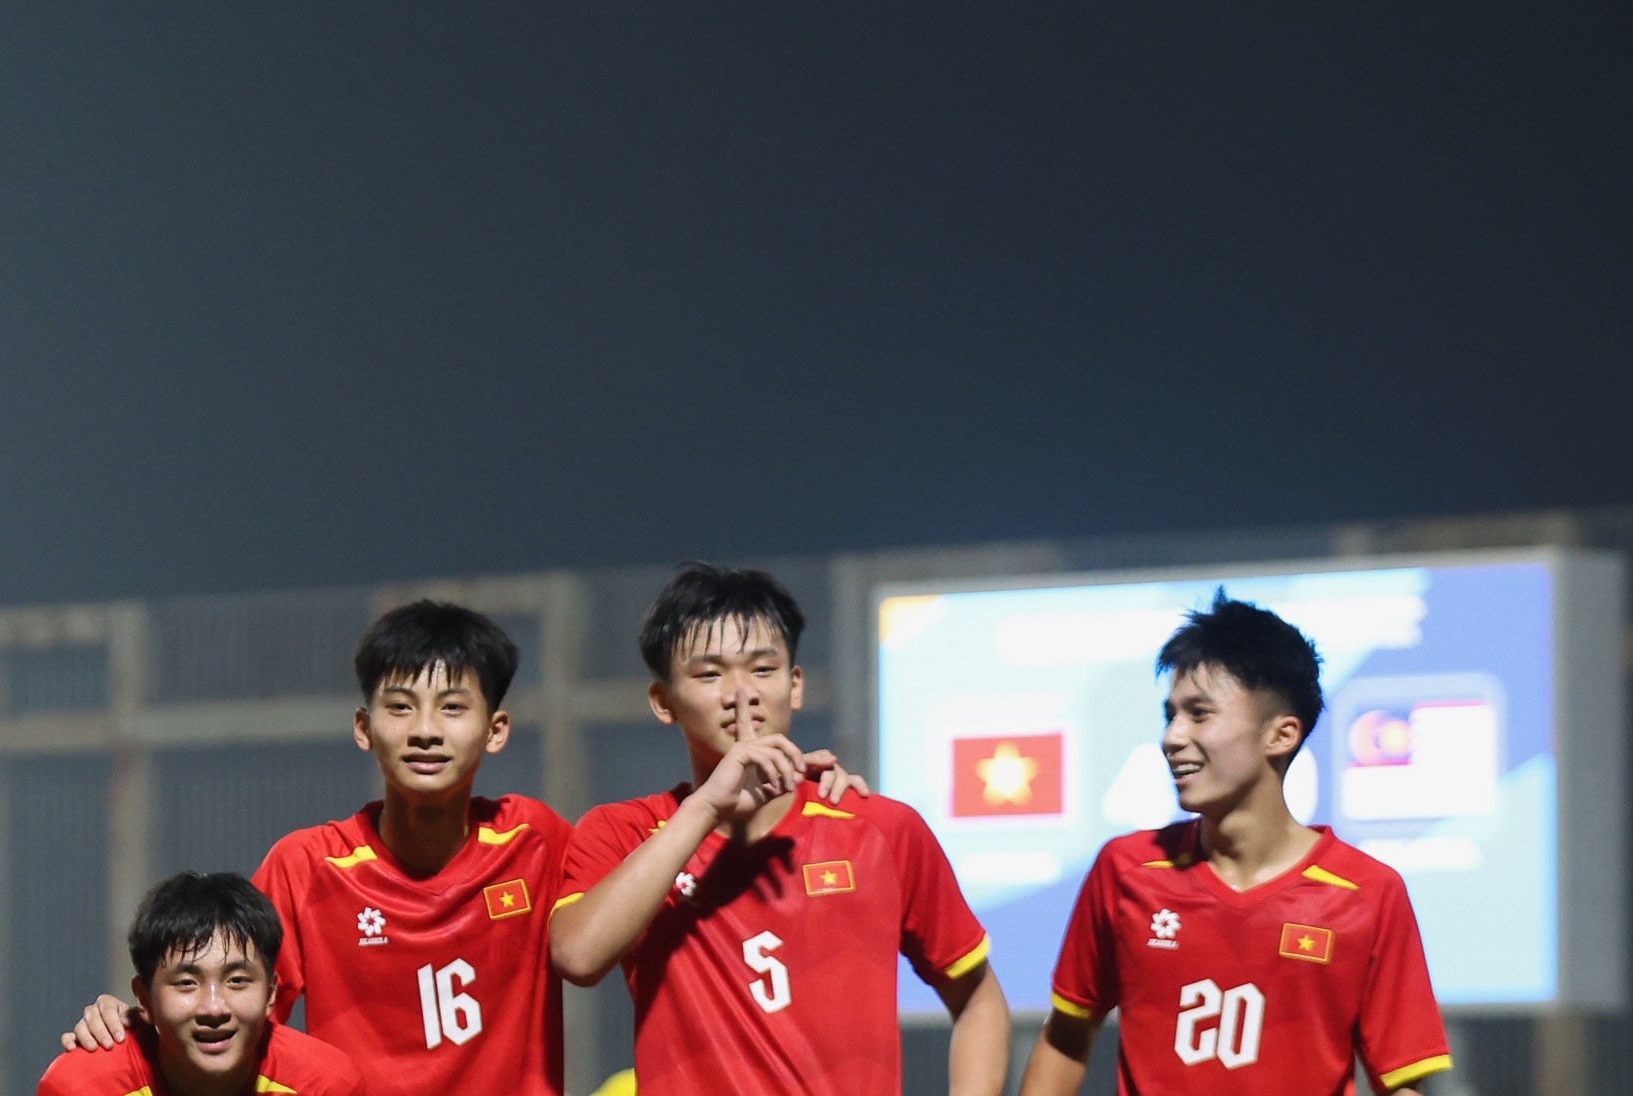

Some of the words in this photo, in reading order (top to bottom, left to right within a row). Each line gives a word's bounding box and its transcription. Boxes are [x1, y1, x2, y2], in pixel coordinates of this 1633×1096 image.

[417, 958, 483, 1050] 16
[742, 930, 793, 1013] 5
[1174, 979, 1265, 1069] 20
